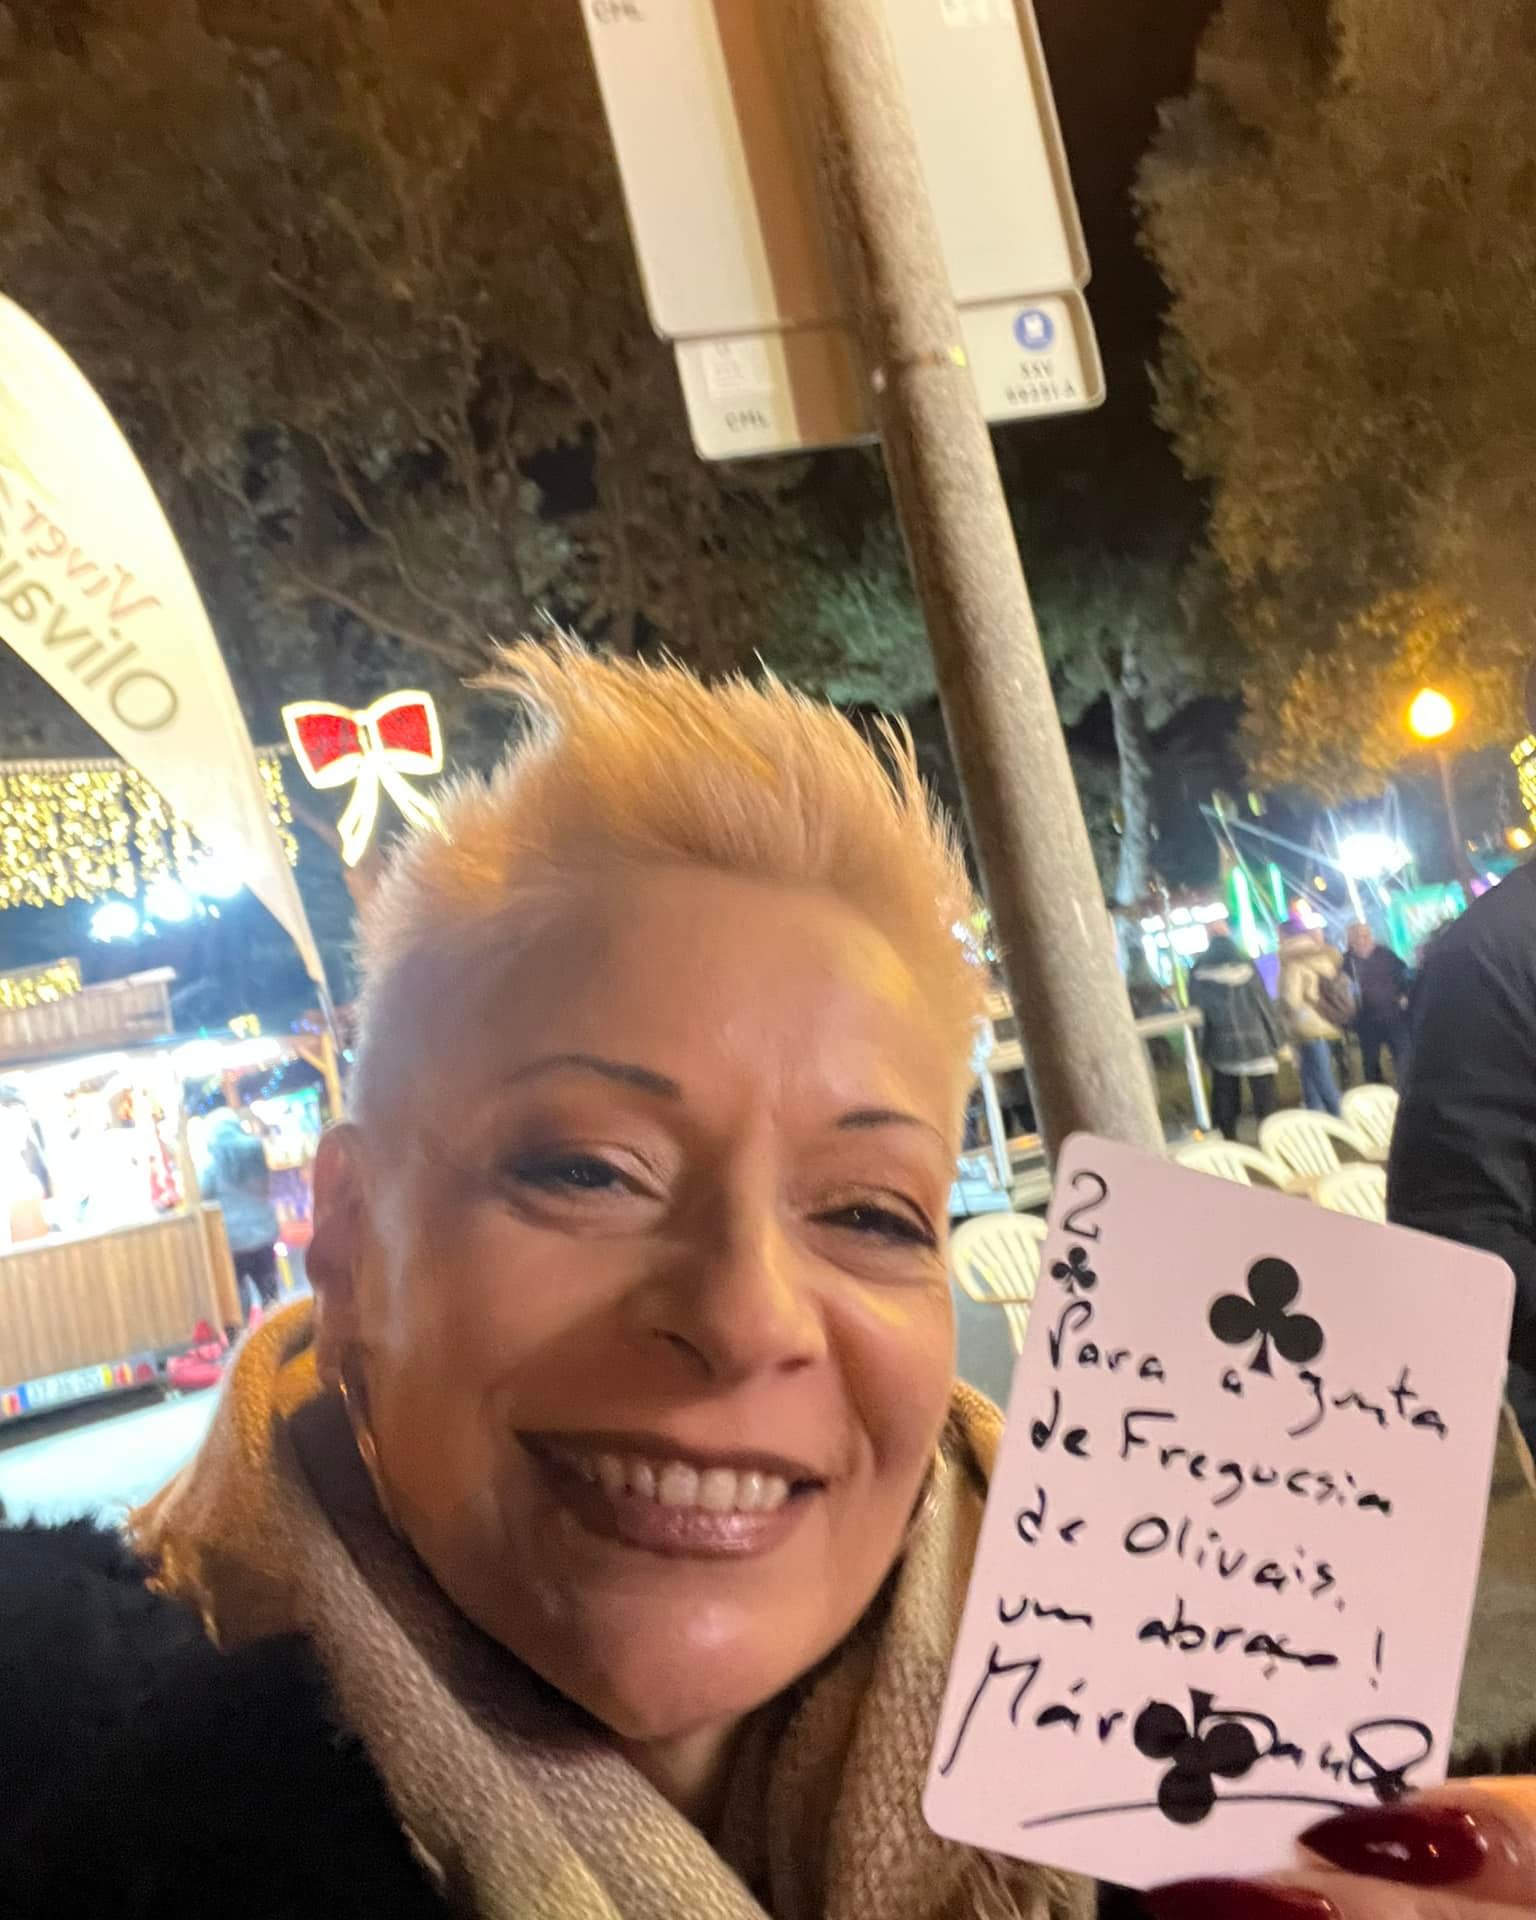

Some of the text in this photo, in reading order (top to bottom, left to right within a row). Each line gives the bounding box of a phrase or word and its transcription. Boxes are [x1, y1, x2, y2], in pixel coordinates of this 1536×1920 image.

[1063, 1169, 1108, 1239] 2
[1049, 1299, 1167, 1384] Para
[1029, 1387, 1093, 1461] de
[1015, 1483, 1087, 1545] de
[997, 1593, 1094, 1633] um
